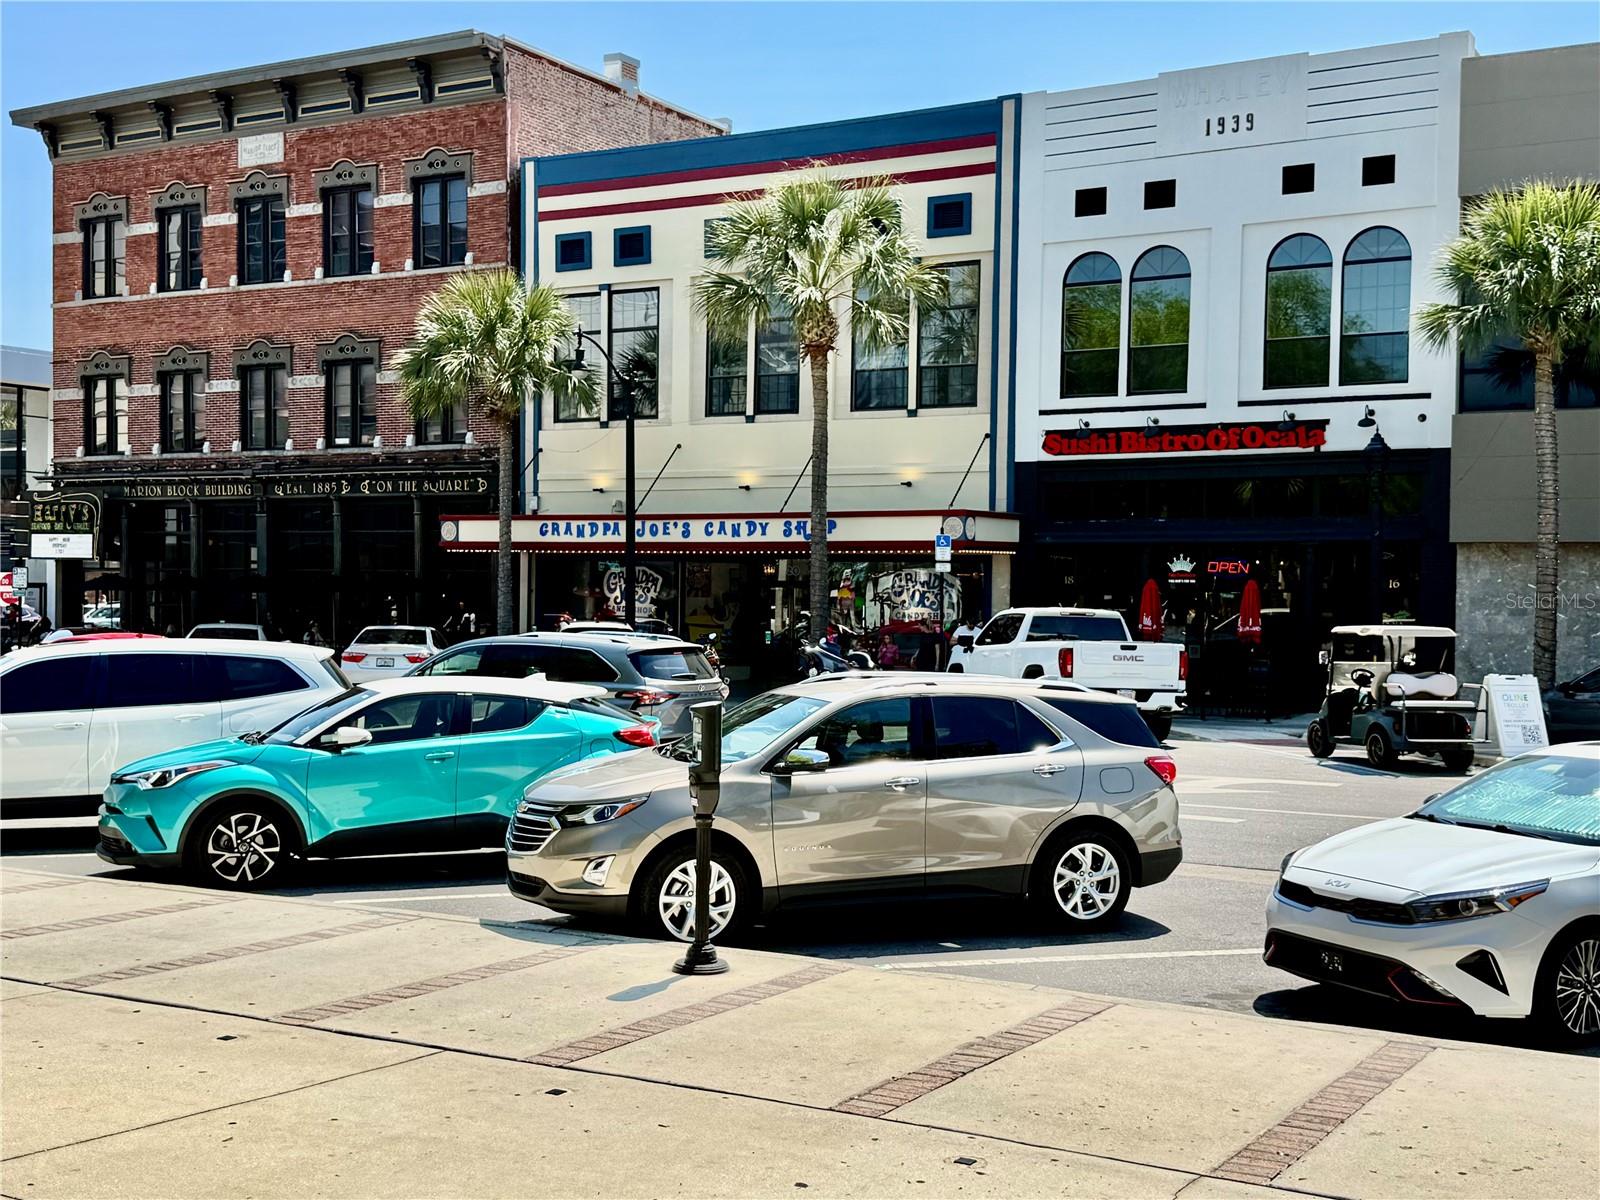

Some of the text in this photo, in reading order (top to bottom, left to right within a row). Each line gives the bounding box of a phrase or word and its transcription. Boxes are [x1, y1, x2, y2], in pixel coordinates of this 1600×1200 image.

[1168, 64, 1293, 108] WHALEY
[1205, 112, 1254, 136] 1939
[1043, 424, 1327, 456] Sushi Bistro Of Ocala
[123, 483, 251, 497] MARION BLOCK BUILDING
[312, 481, 337, 494] 1885
[398, 480, 417, 492] THE
[539, 518, 838, 541] GRANDPA JOE'S CANDY SHP
[1207, 561, 1250, 574] OPEN
[1389, 579, 1400, 589] 16
[928, 612, 952, 620] SHP
[1112, 654, 1145, 662] GMC
